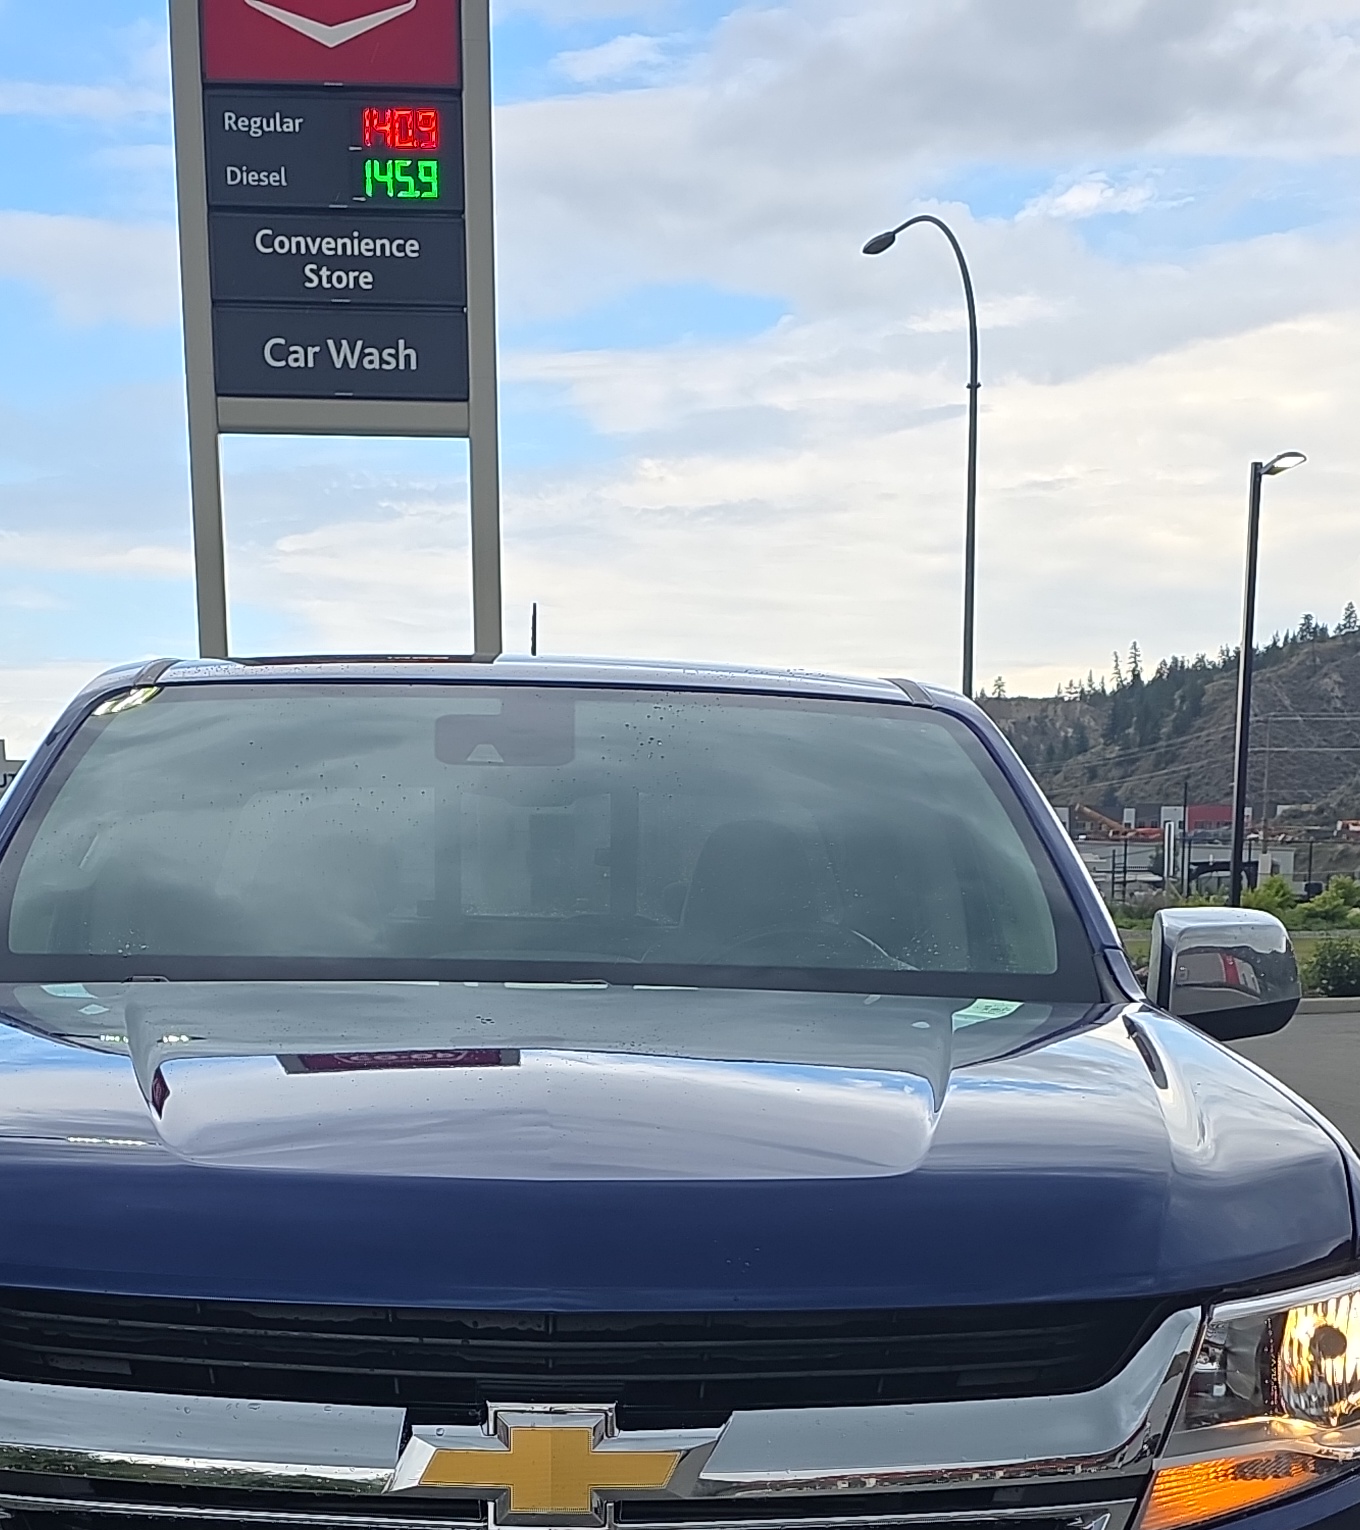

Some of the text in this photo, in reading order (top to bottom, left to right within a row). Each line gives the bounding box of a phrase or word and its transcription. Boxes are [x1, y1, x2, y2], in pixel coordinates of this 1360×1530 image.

[223, 111, 304, 138] Regular
[226, 165, 288, 187] Diesel
[254, 228, 421, 258] Convenience
[303, 263, 374, 290] Store
[263, 337, 418, 371] Car Wash
